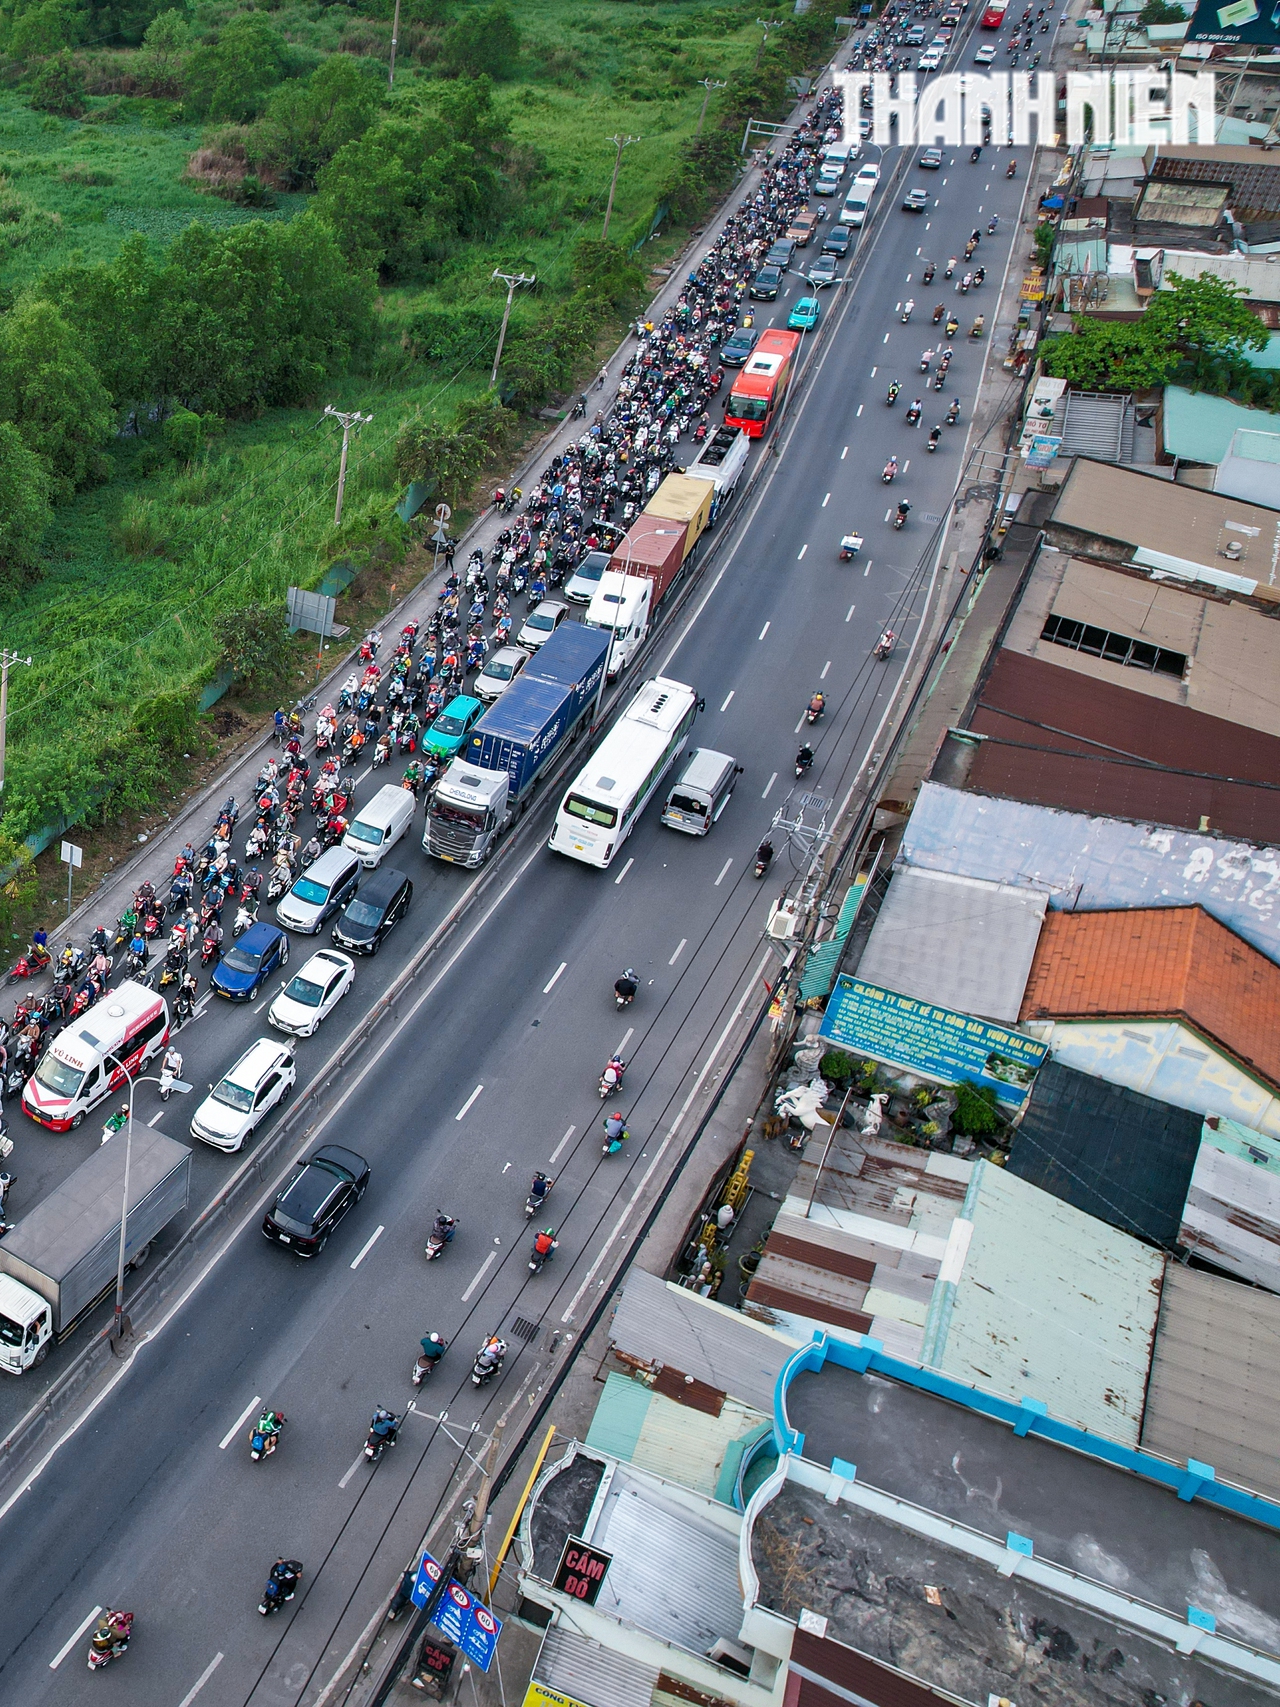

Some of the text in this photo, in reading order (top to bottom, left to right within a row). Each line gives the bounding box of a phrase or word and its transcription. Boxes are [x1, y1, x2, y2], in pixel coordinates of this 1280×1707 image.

[449, 787, 477, 802] CHENGLONG
[885, 993, 897, 1006] TY
[64, 1053, 84, 1069] LINH
[563, 1549, 605, 1599] CẦM ĐỒ
[454, 1590, 464, 1602] 60
[480, 1615, 491, 1627] 60
[535, 1687, 564, 1704] CÔNG
